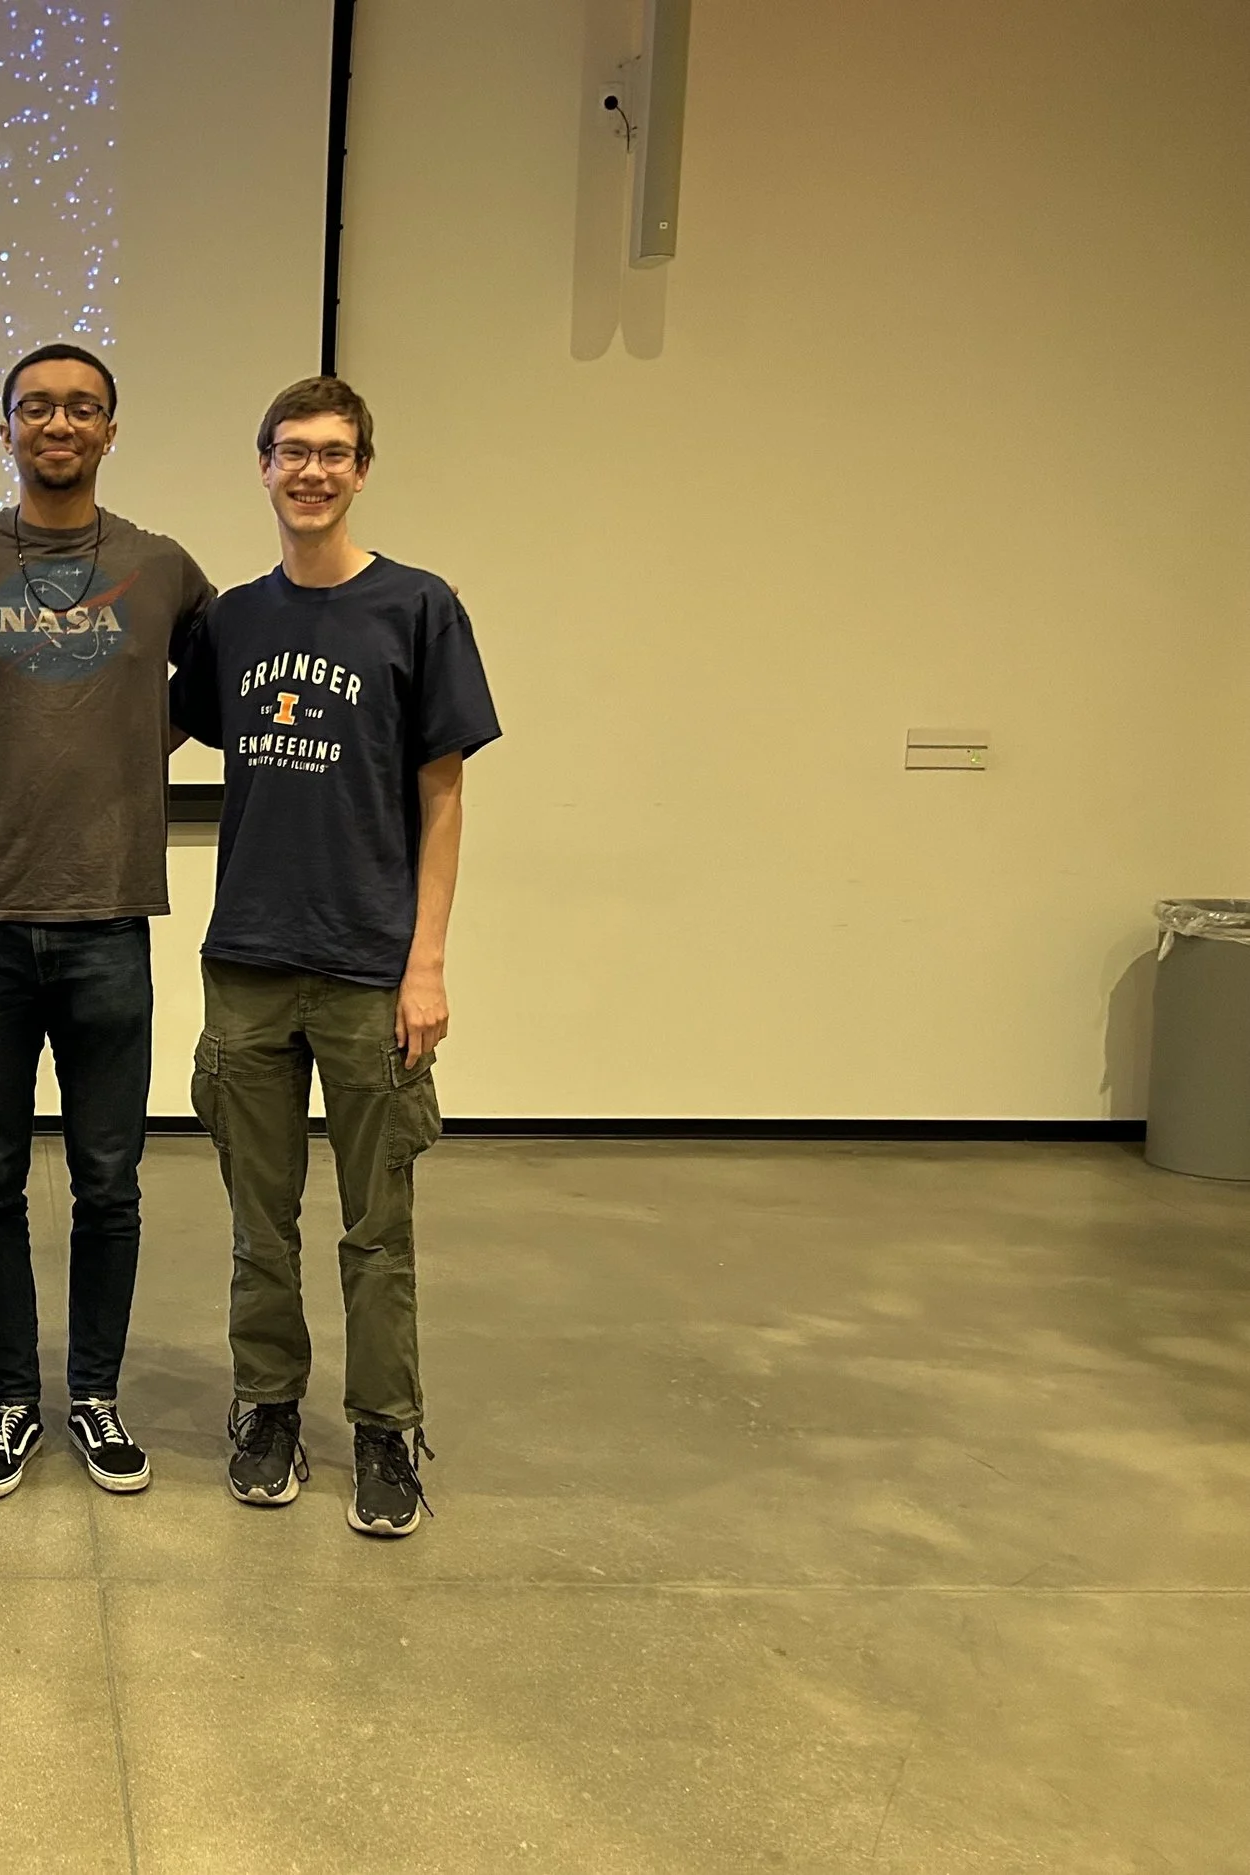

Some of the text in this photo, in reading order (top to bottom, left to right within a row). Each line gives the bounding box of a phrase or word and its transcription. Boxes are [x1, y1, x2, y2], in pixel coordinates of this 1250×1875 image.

[241, 652, 362, 705] GRAINGER
[239, 733, 342, 762] ENNEERING
[248, 755, 274, 767] UNITY
[277, 759, 288, 768] OF
